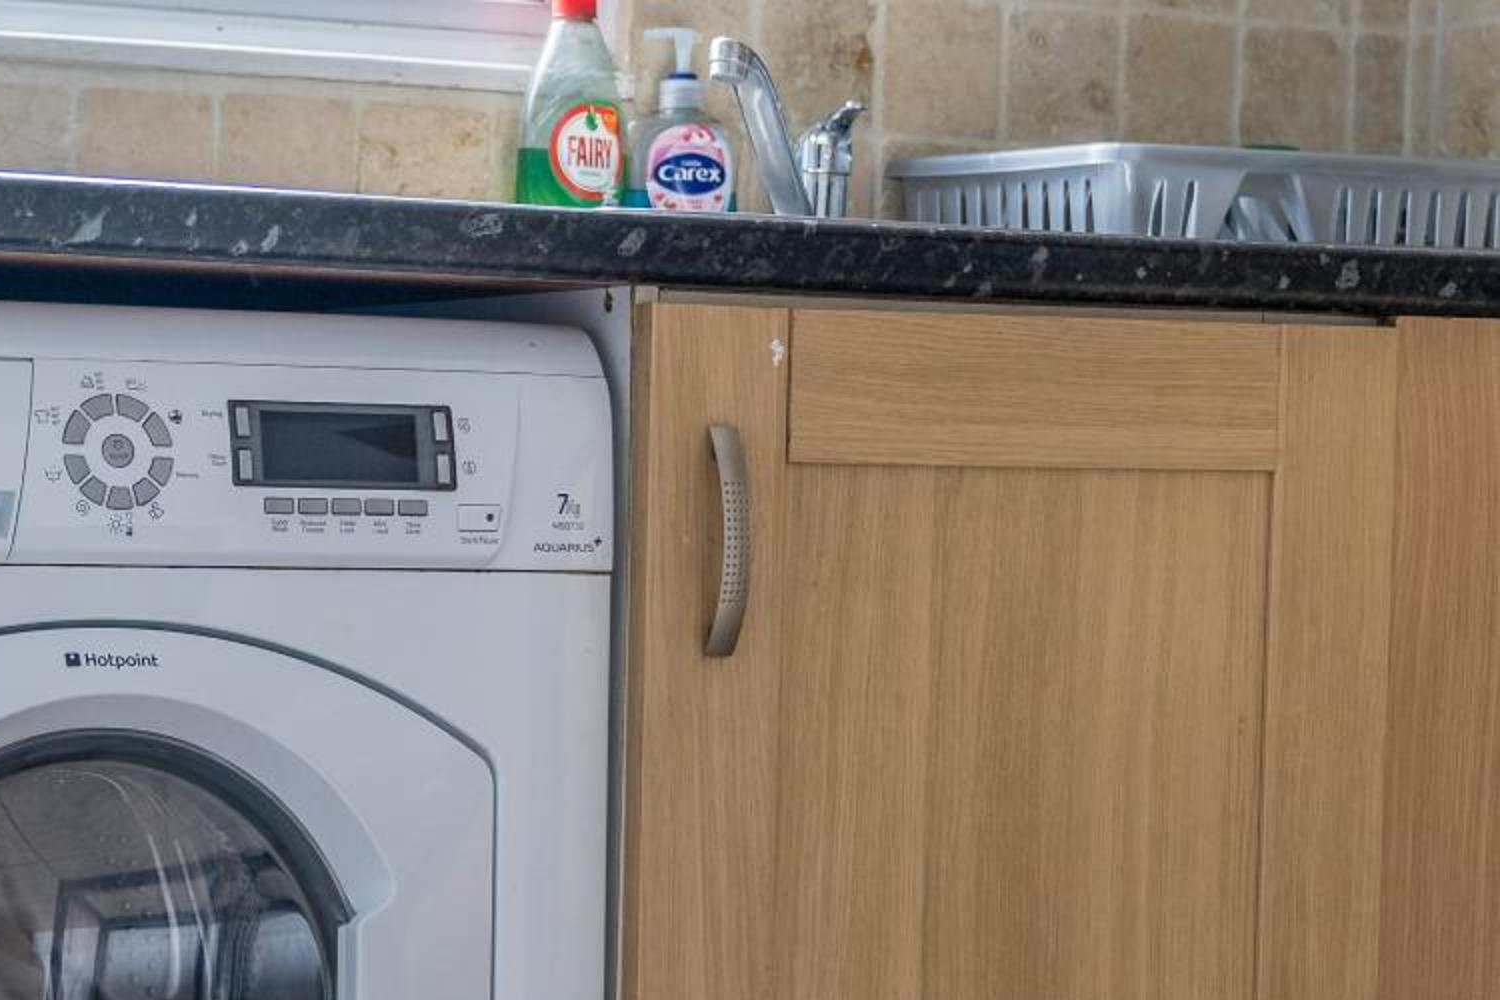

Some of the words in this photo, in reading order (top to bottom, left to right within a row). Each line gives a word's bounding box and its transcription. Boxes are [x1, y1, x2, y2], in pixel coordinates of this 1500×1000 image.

[567, 135, 612, 169] FAIRY
[658, 163, 722, 183] Carex
[84, 651, 159, 671] Hotpoint
